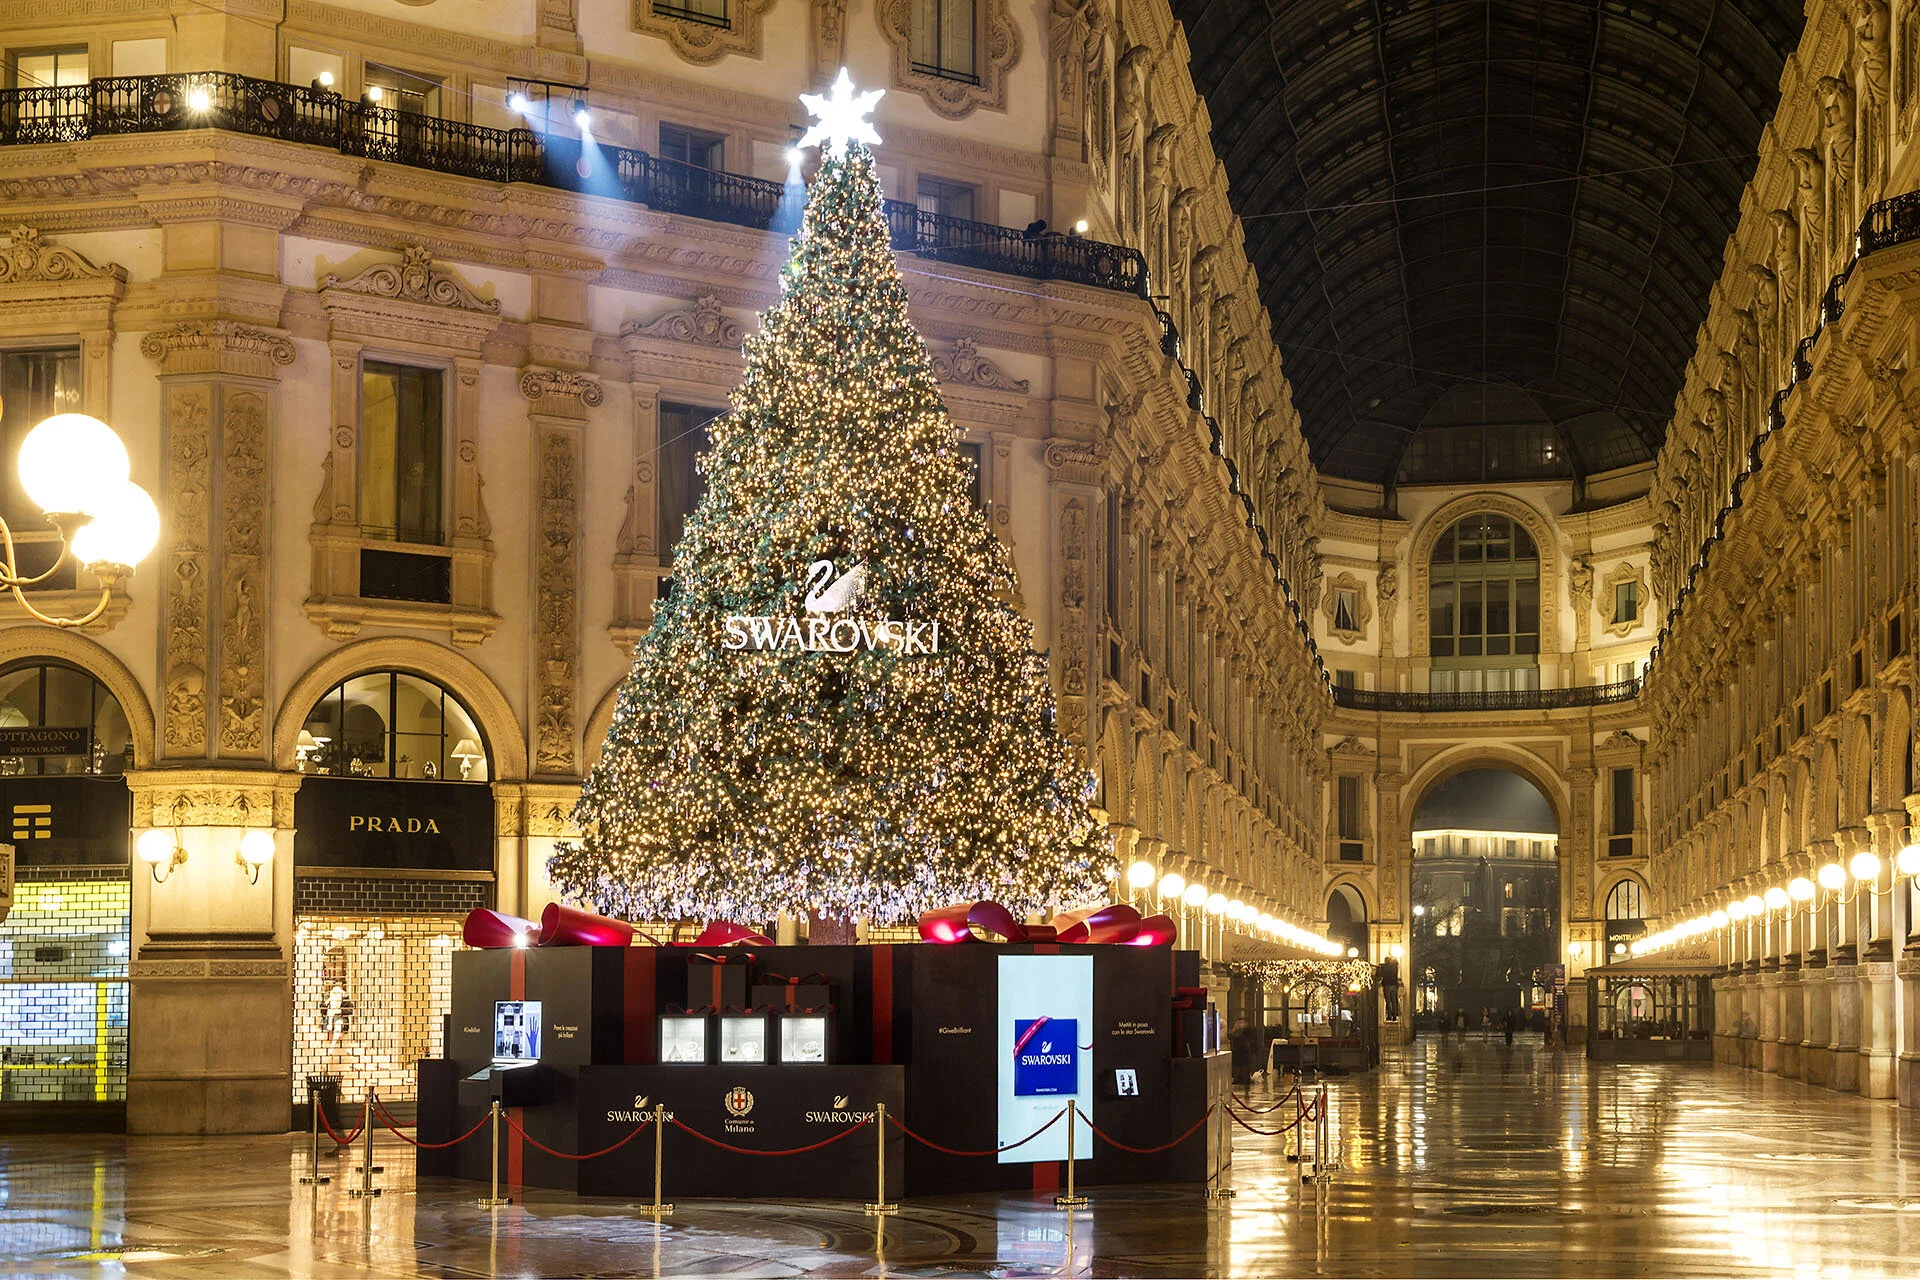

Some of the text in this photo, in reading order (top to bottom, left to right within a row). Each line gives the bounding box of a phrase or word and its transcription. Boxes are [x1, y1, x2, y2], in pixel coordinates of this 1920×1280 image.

[725, 615, 940, 655] SWAROVSKI
[0, 730, 80, 741] OTTAGONO
[350, 815, 440, 834] PRADA
[1021, 1054, 1071, 1066] SWAROVSKI
[724, 1124, 755, 1133] Milano
